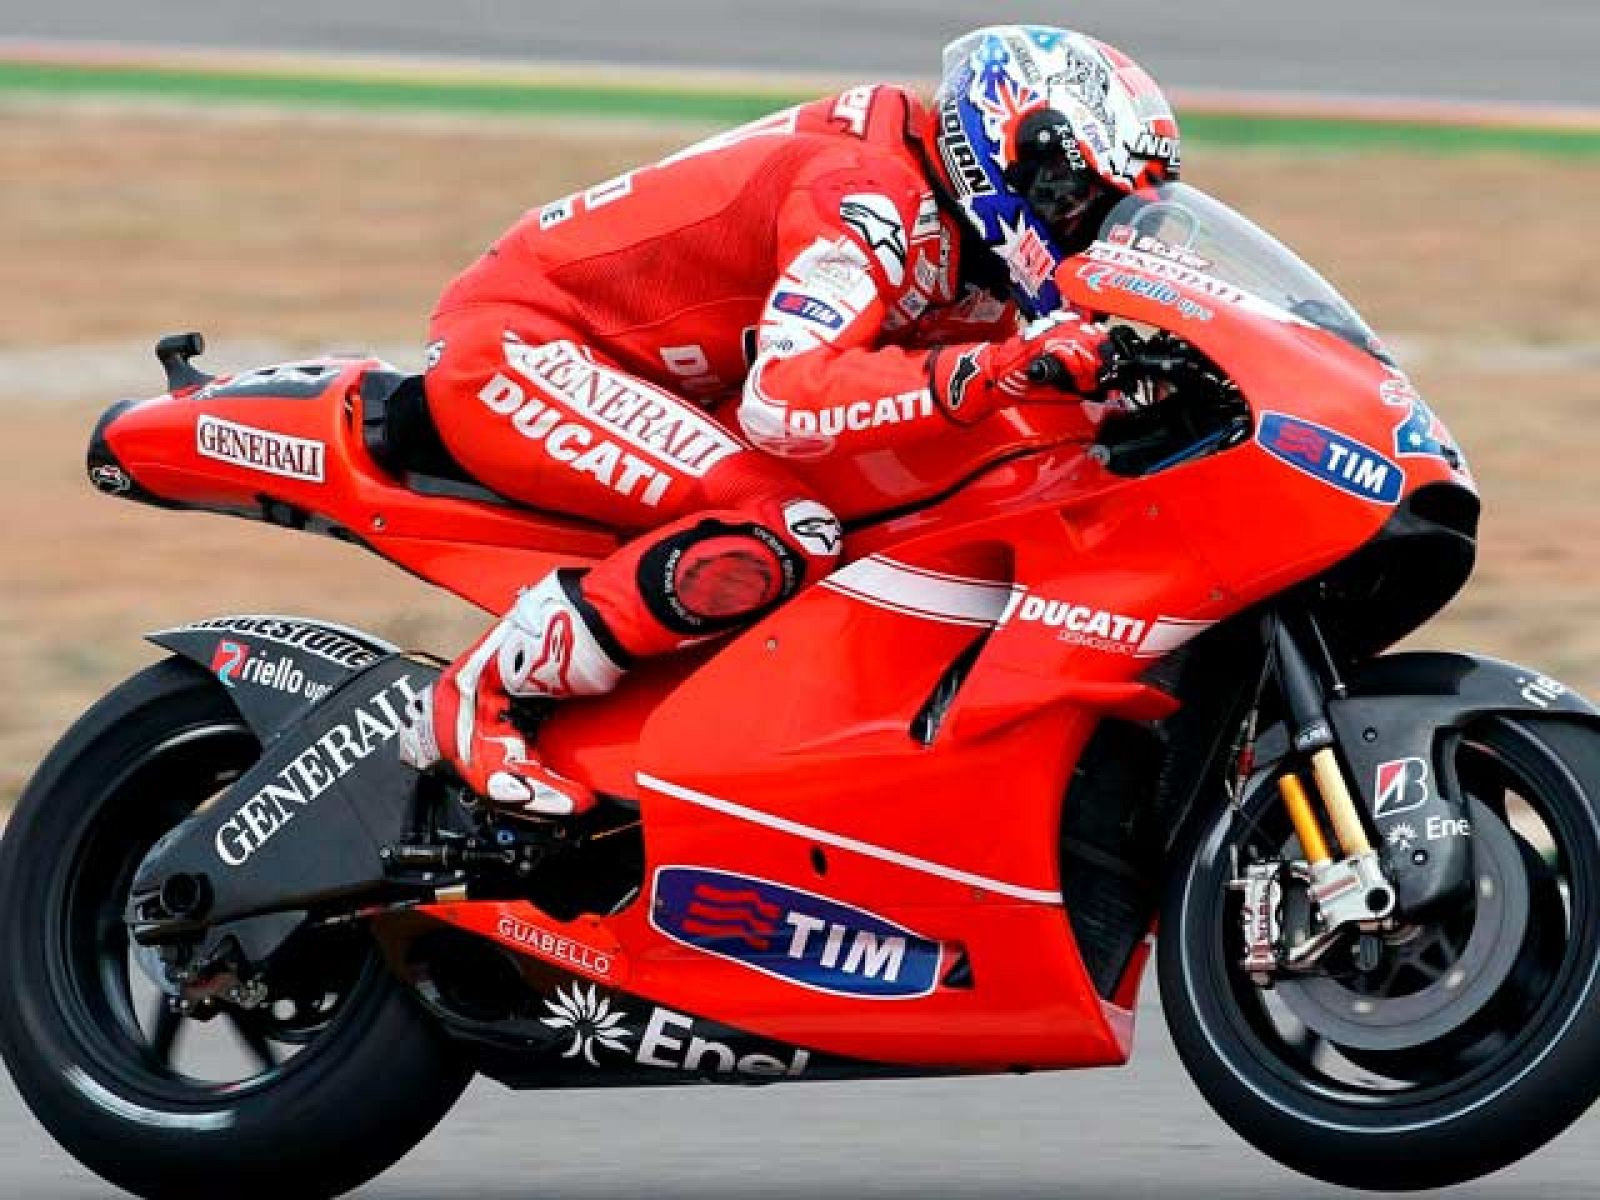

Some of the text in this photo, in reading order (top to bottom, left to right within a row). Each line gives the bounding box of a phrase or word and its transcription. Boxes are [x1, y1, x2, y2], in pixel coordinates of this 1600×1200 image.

[478, 372, 672, 507] DUCATI
[789, 387, 934, 437] DUCATI
[199, 421, 321, 477] GENERALI
[1326, 442, 1389, 494] TIM
[1019, 594, 1146, 643] DUCATI
[243, 650, 302, 684] riello
[498, 918, 610, 974] GUABELLO
[786, 911, 907, 983] TIM
[635, 1006, 811, 1077] Enel
